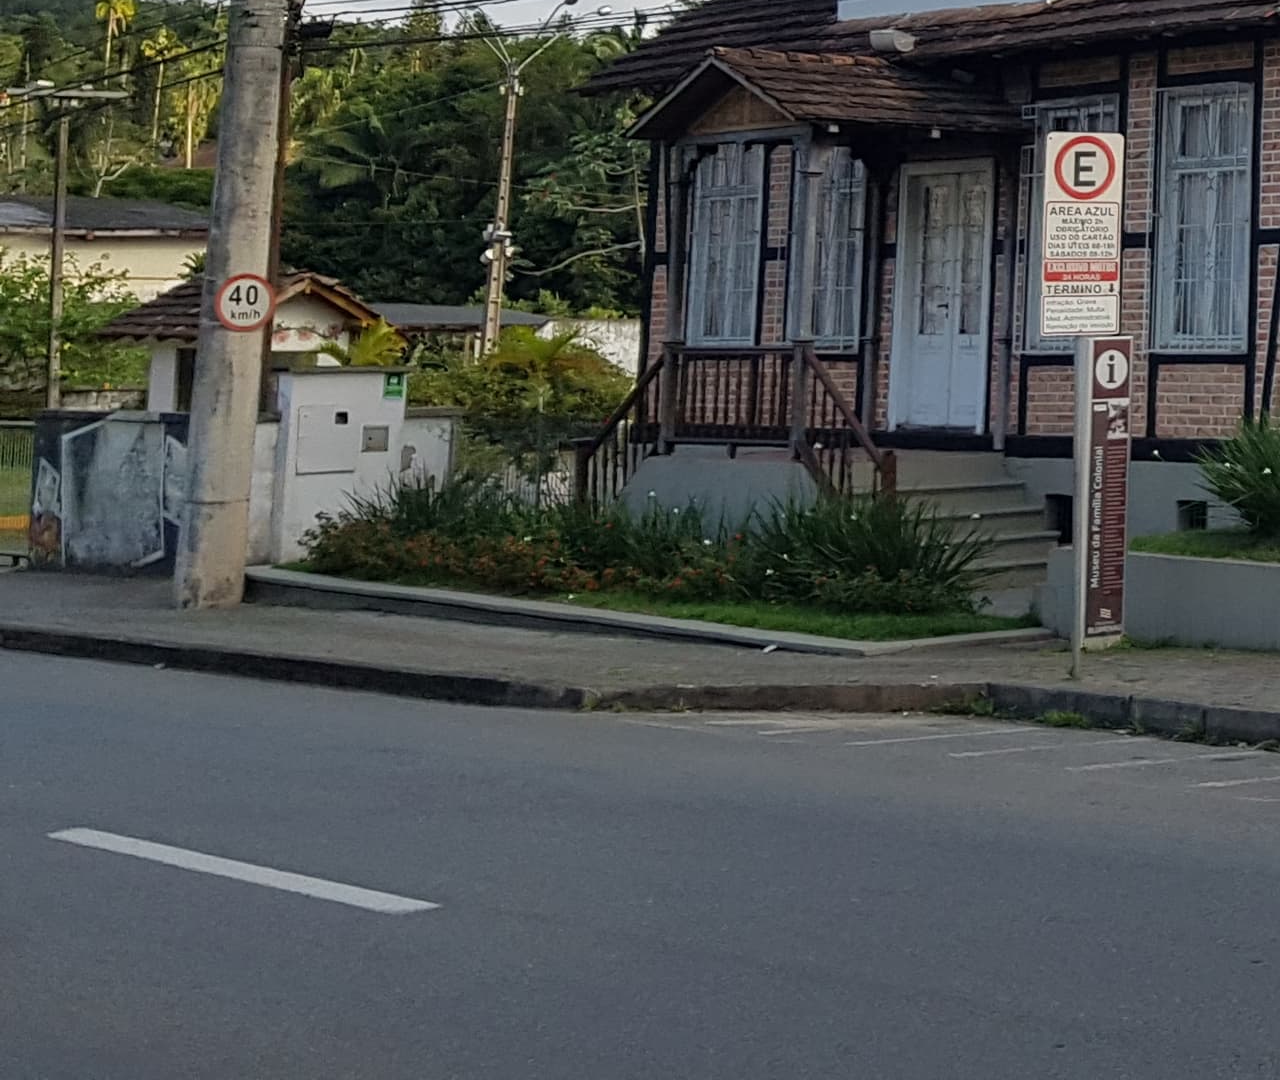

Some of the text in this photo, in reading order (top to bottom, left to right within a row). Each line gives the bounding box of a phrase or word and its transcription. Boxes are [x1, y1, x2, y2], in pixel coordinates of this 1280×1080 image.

[1073, 151, 1097, 187] E
[1085, 207, 1114, 216] AZUL
[228, 284, 258, 306] 40
[230, 309, 261, 320] km/h
[1090, 445, 1104, 589] Museu da Família Colonial
